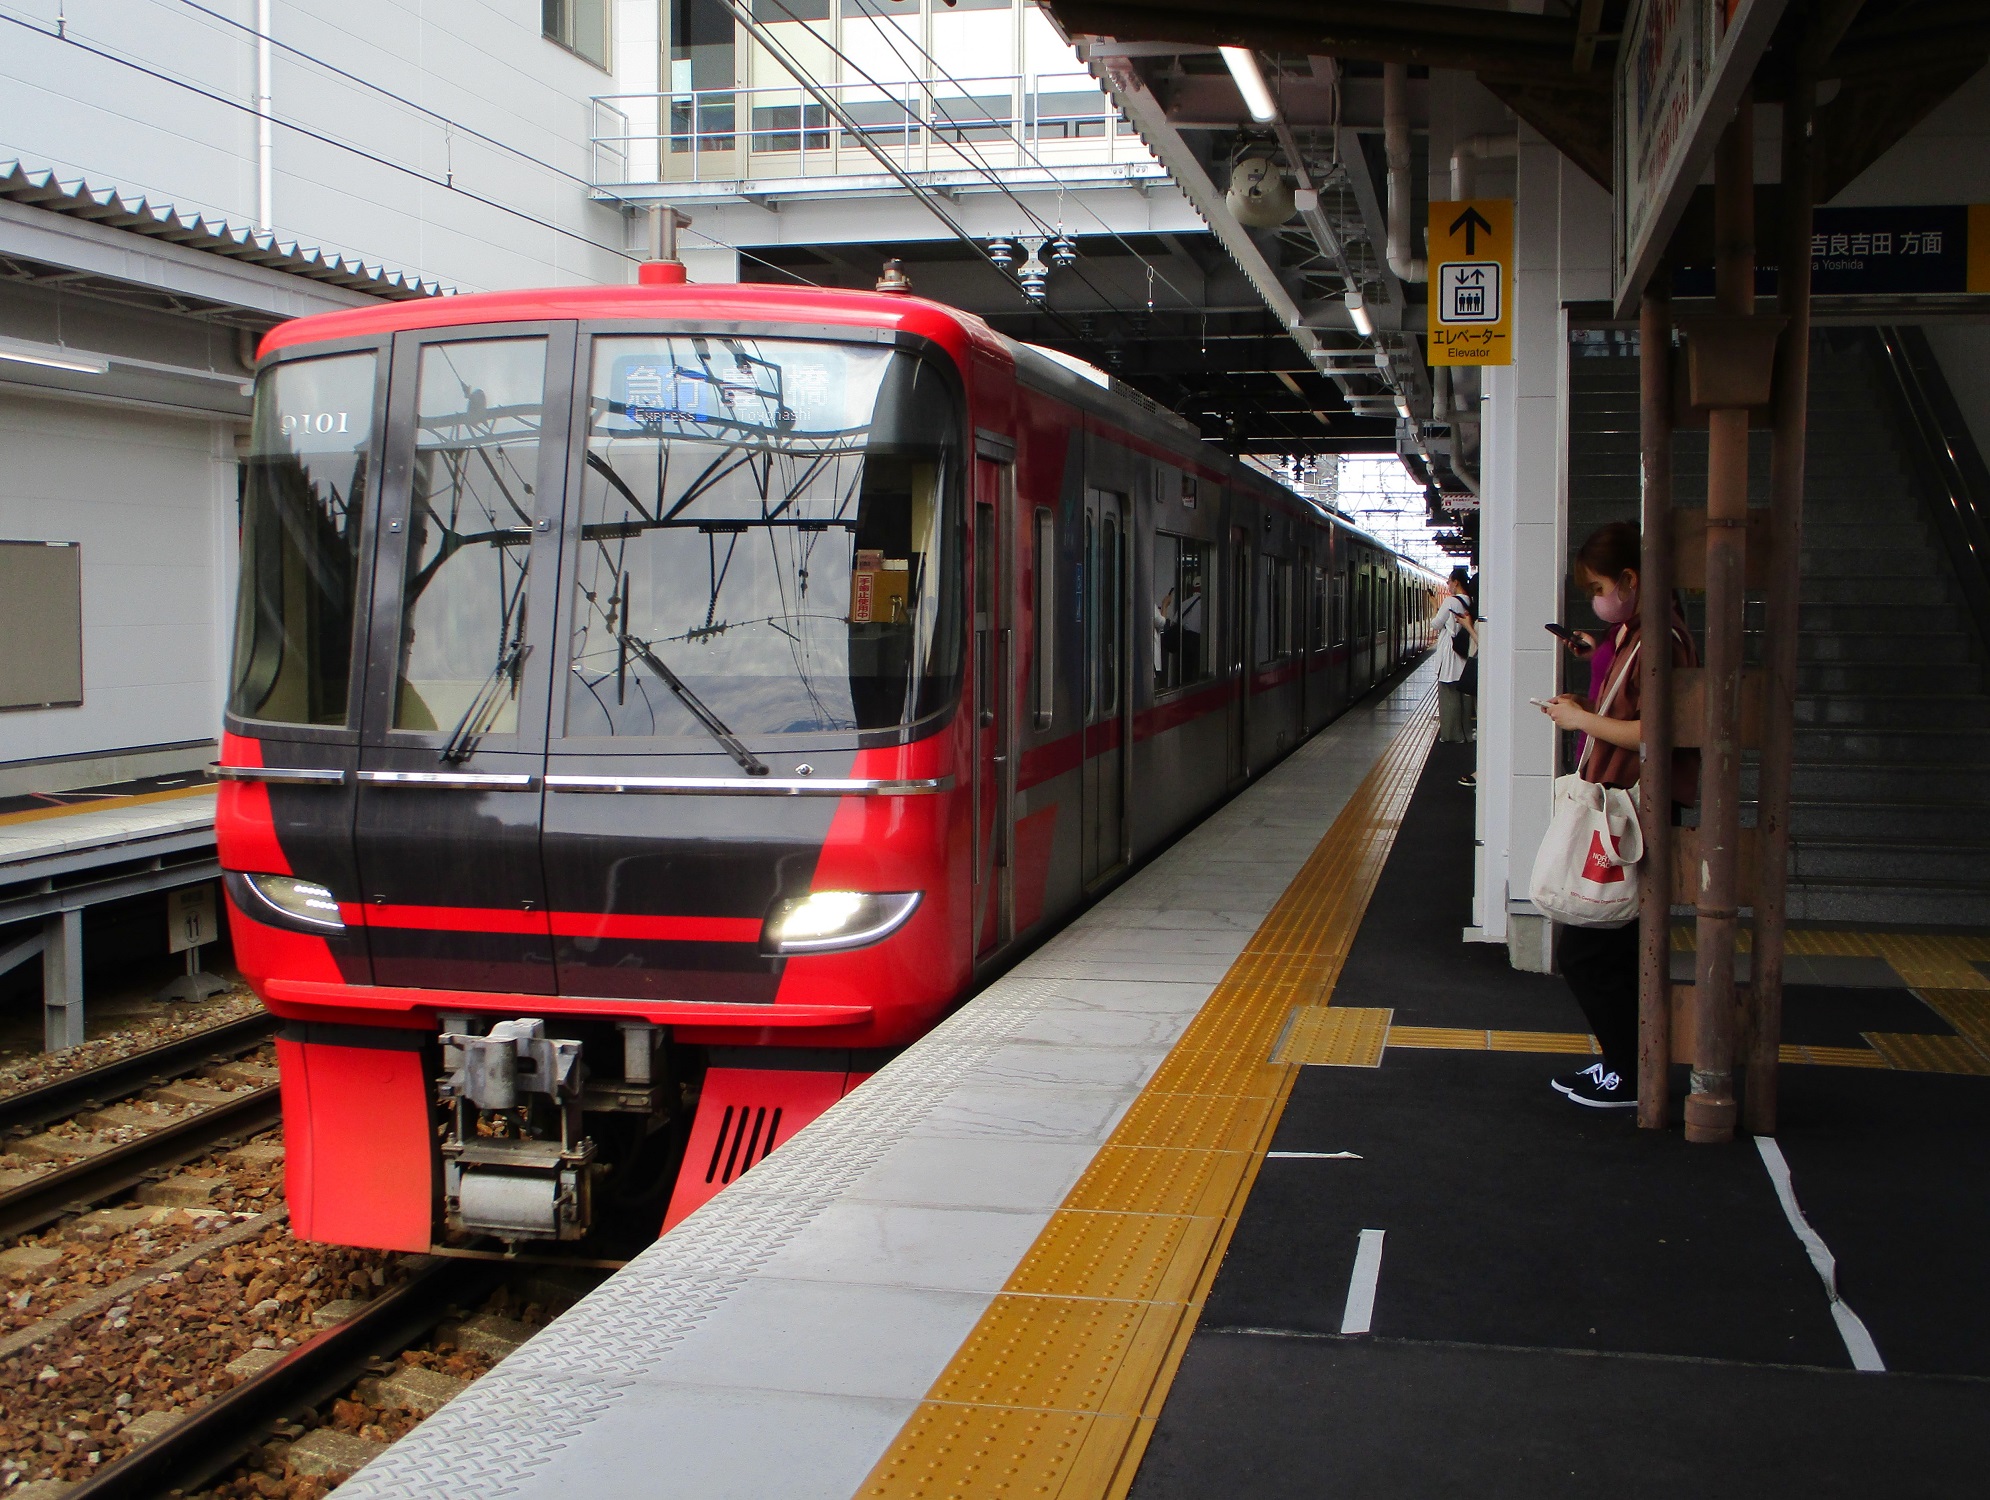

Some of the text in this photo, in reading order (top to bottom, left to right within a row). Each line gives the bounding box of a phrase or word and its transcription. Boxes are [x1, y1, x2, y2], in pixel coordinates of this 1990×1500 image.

[1811, 231, 1943, 256] 吉良吉田 方面
[1822, 259, 1864, 271] Yoshida
[1433, 329, 1506, 345] エレベーター
[1448, 348, 1490, 358] Elevator
[626, 365, 702, 407] 急行
[635, 408, 697, 422] Express
[280, 412, 349, 435] 9101
[1596, 860, 1611, 869] FAC
[187, 915, 199, 938] 11
